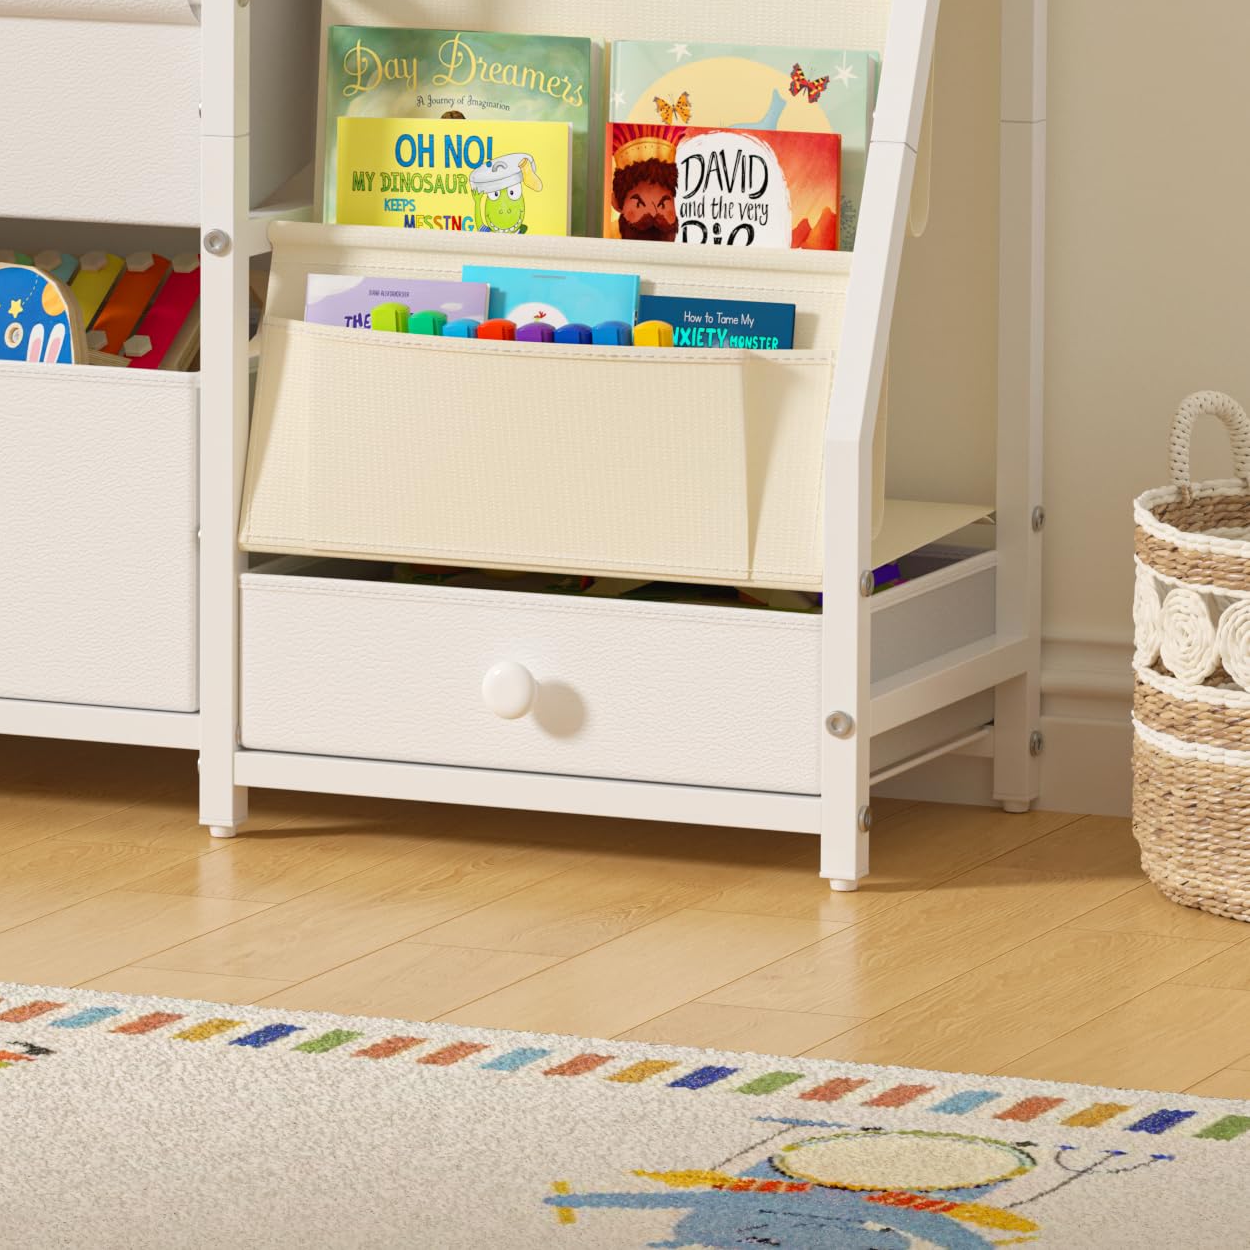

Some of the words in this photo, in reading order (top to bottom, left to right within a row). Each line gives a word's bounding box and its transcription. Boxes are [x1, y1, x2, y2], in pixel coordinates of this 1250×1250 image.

[342, 38, 418, 97] Day
[432, 32, 583, 108] Dreamers
[427, 94, 456, 108] Journey
[457, 95, 466, 105] of
[467, 95, 511, 111] Imagination
[395, 133, 435, 168] OH
[444, 134, 494, 169] NO!
[351, 170, 376, 192] MY
[379, 171, 470, 195] DINOSAUR
[679, 149, 769, 200] DAVID
[383, 197, 417, 213] KEEPS
[680, 195, 706, 219] and
[710, 195, 735, 219] the
[737, 200, 770, 226] very
[344, 312, 372, 329] THE
[683, 311, 702, 323] How
[704, 313, 714, 324] to
[716, 312, 739, 325] Tame
[740, 313, 755, 328] My
[672, 327, 728, 348] NXIETY
[729, 335, 779, 350] MONSTER
